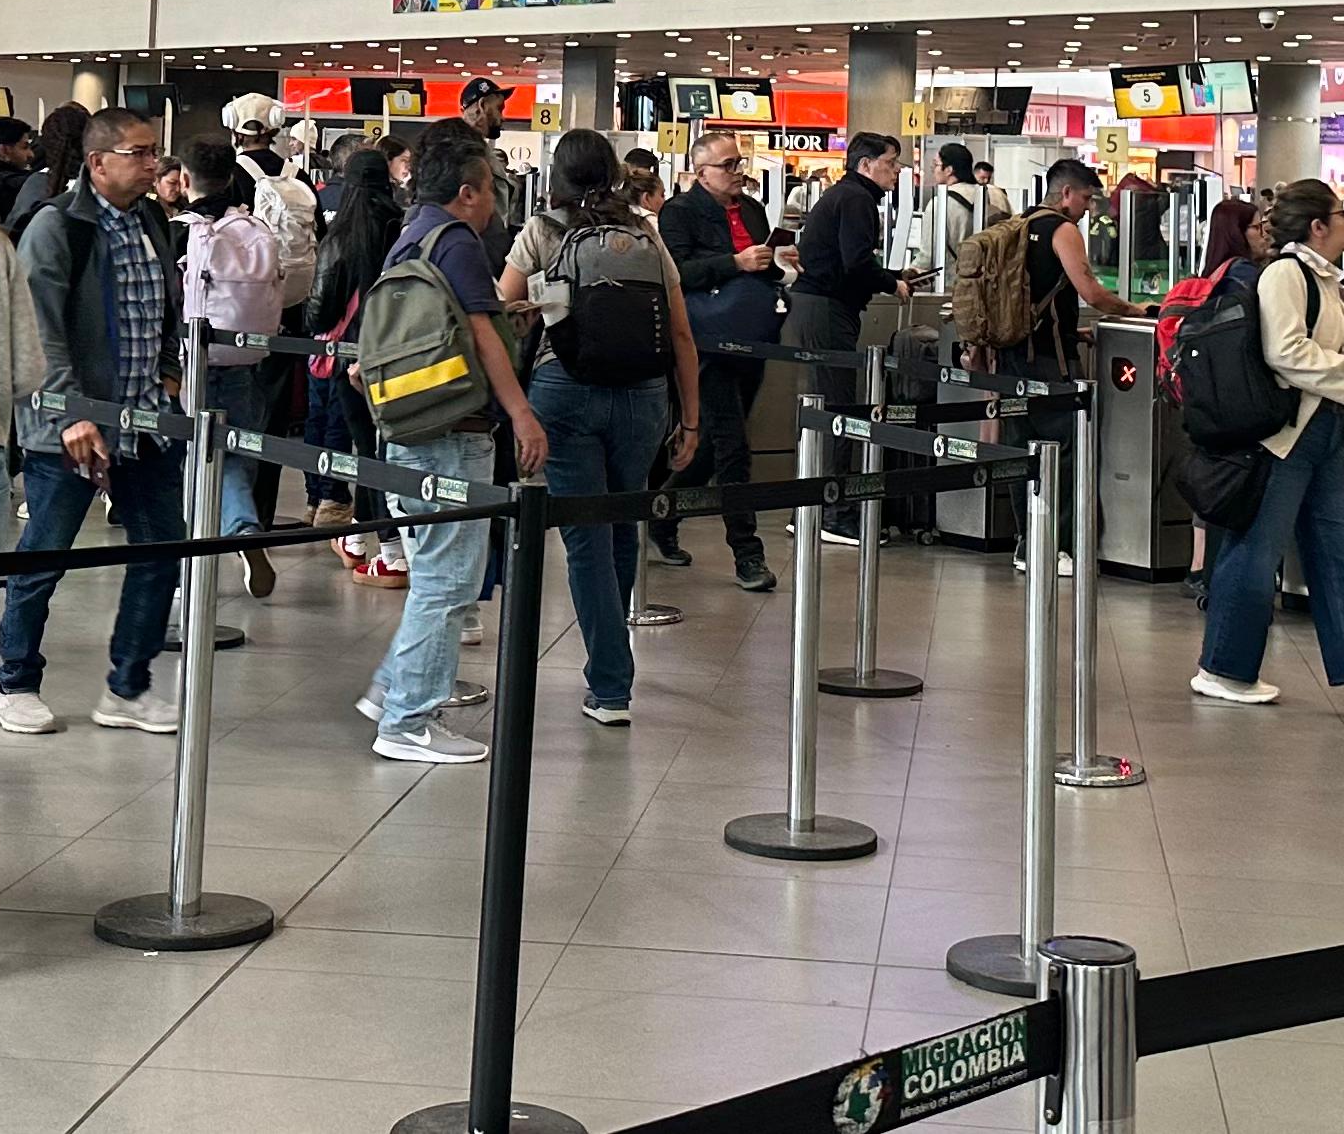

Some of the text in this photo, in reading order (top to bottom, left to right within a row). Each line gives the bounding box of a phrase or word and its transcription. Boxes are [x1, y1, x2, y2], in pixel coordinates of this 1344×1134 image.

[741, 97, 748, 109] 3
[1143, 89, 1151, 103] 5
[540, 109, 551, 125] 8
[909, 111, 918, 128] 6
[1036, 116, 1050, 133] IVA
[372, 127, 382, 139] 9
[666, 129, 680, 147] 7
[774, 134, 822, 151] DIOR
[1106, 134, 1118, 153] 5
[904, 1041, 1026, 1100] COLOMBIA
